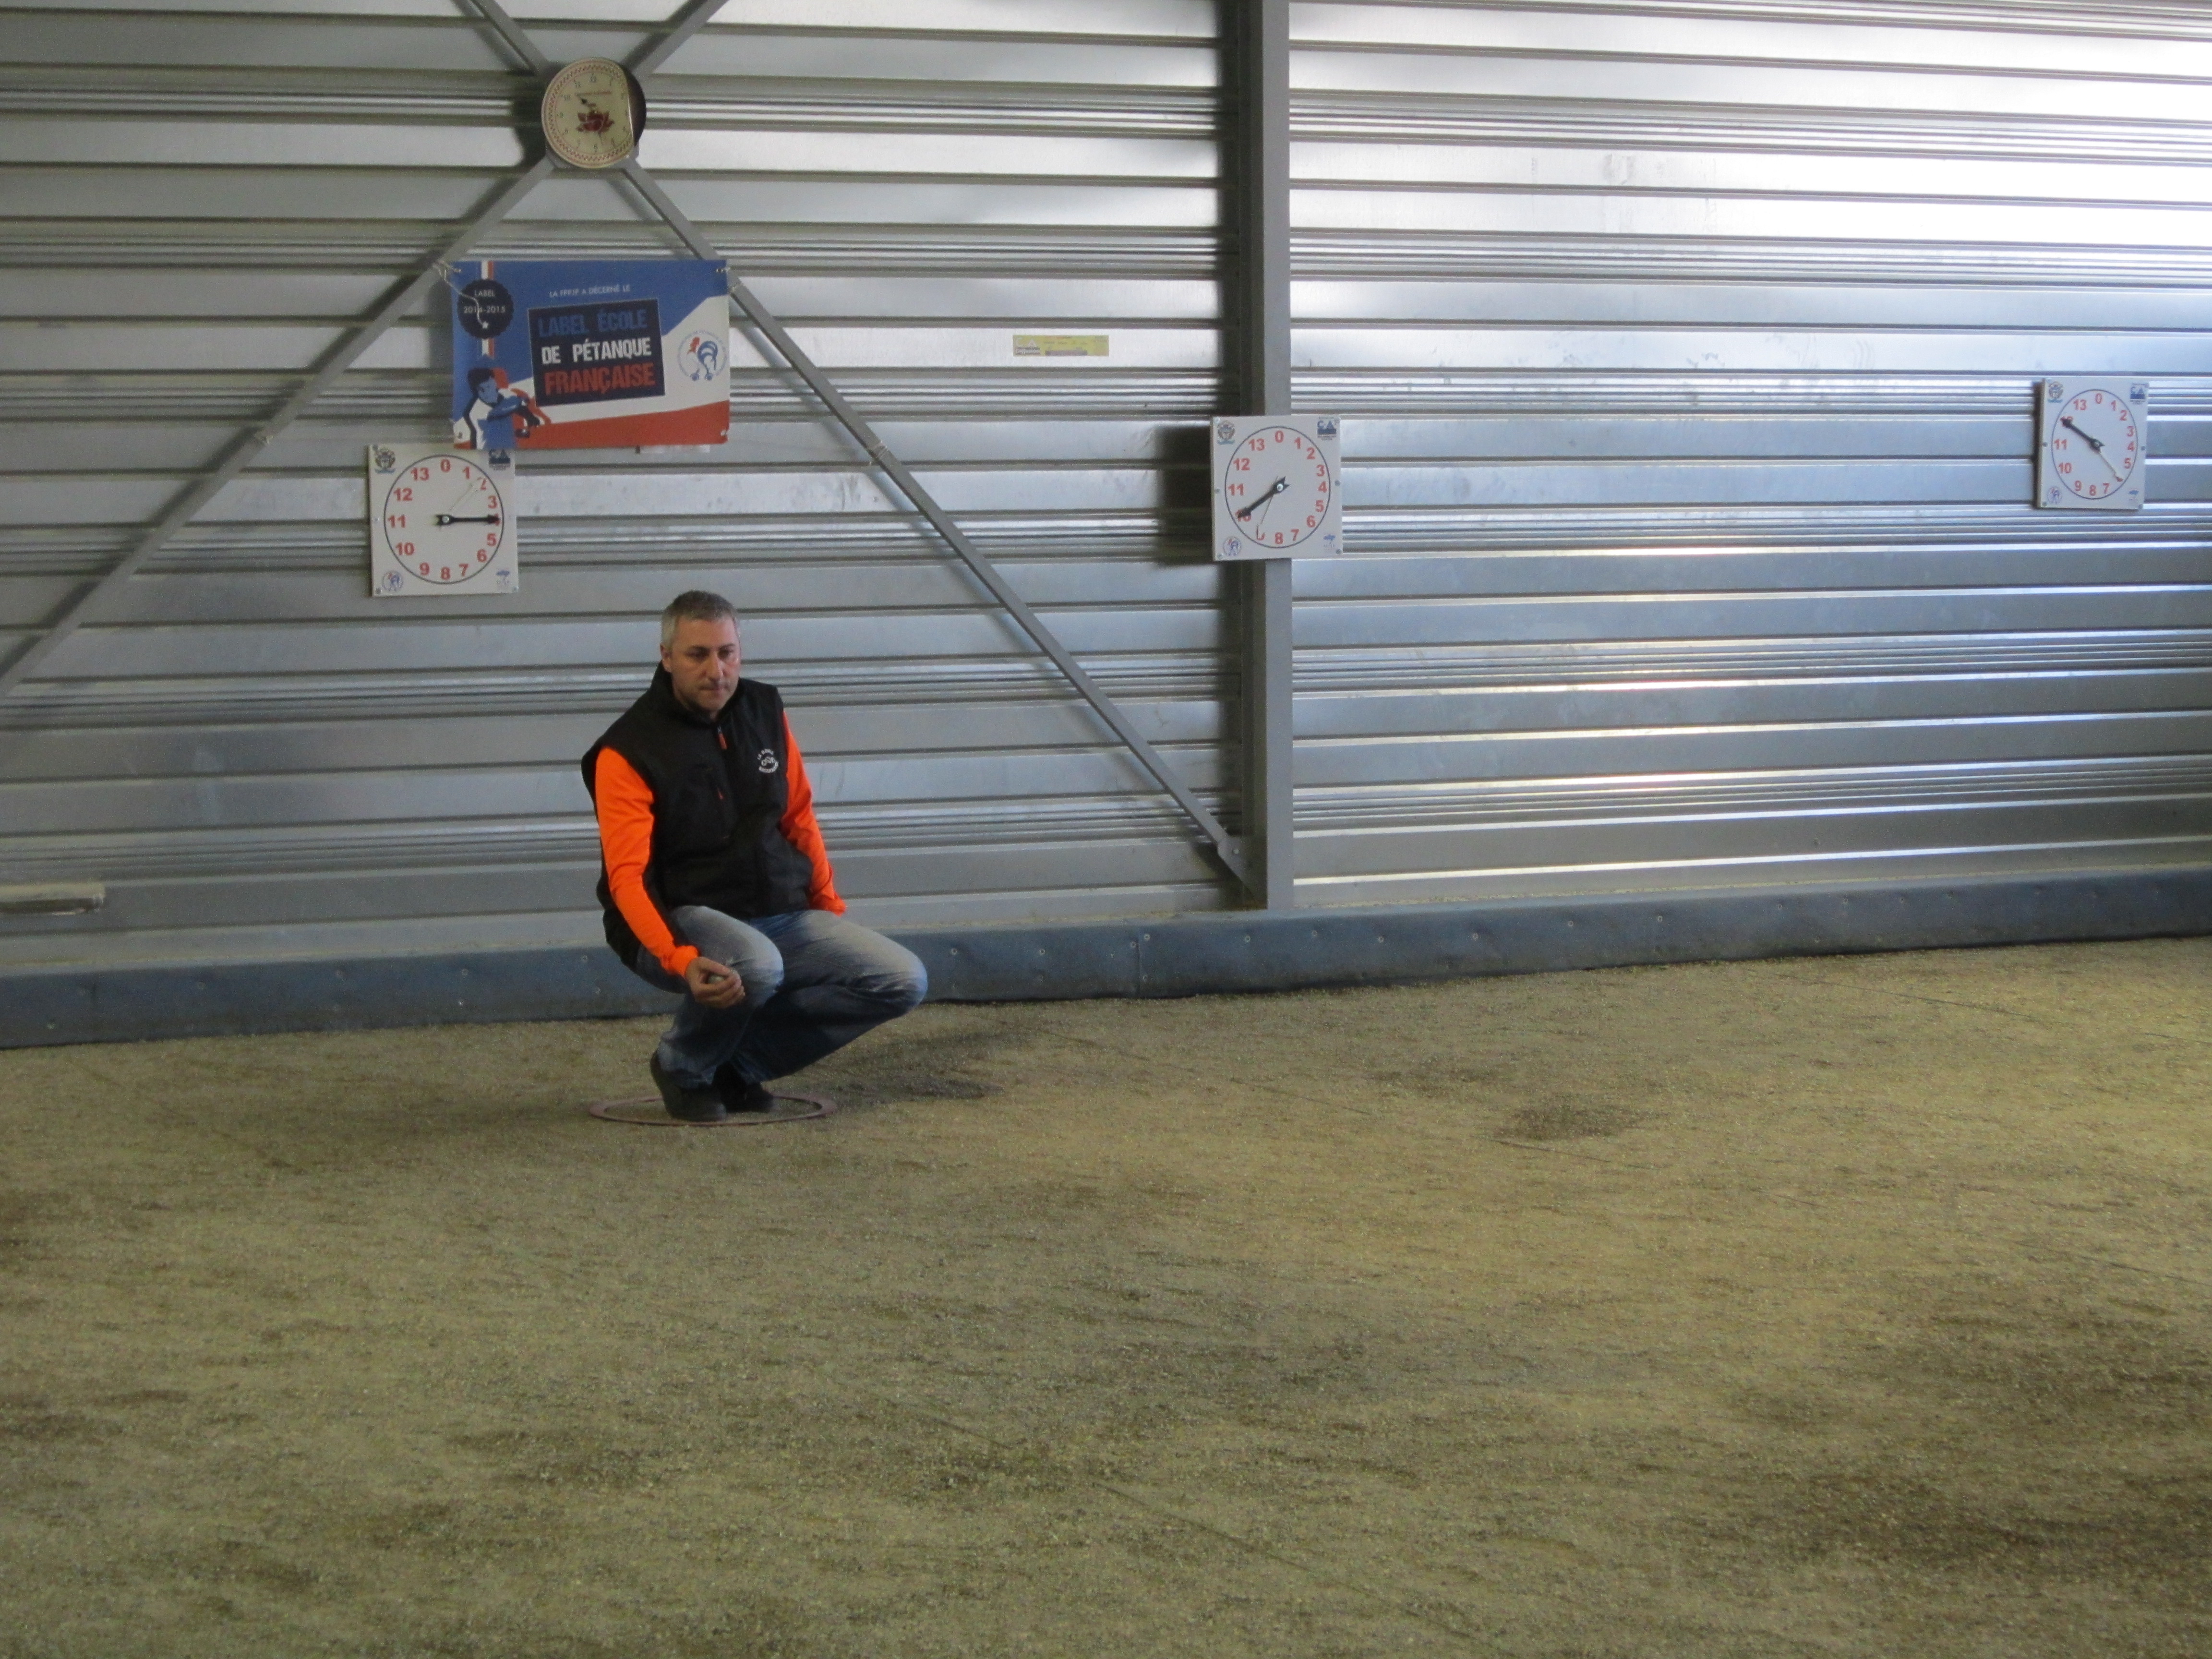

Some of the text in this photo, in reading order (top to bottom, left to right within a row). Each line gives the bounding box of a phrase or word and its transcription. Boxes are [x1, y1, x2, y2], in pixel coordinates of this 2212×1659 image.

[474, 289, 495, 297] LABEL
[589, 284, 620, 294] DÉCERNÉ
[538, 308, 648, 337] LABEL ÉCOLE
[541, 337, 652, 365] DE PÉTANQUE
[544, 362, 656, 396] FRANÇAISE
[2073, 399, 2087, 410] 13
[2094, 393, 2103, 404] 0
[2111, 400, 2117, 411] 1
[2119, 409, 2128, 421] 2
[1274, 430, 1285, 443] 0
[2126, 425, 2134, 437] 3
[1248, 438, 1265, 451] 13
[1294, 437, 1301, 450] 1
[2054, 439, 2068, 450] 11
[2127, 441, 2135, 452] 4
[1306, 447, 1316, 460] 2
[440, 458, 451, 473] 0
[1233, 457, 1250, 471] 12
[2058, 462, 2072, 474] 10
[2124, 457, 2132, 469] 5
[410, 467, 430, 481] 13
[462, 466, 471, 480] 1
[1316, 464, 1325, 477] 3
[1228, 483, 1245, 496] 11
[1318, 481, 1328, 493] 4
[2074, 480, 2082, 492] 9
[2089, 484, 2097, 496] 8
[2102, 482, 2110, 494] 7
[393, 488, 413, 502] 12
[488, 495, 498, 509] 3
[1315, 500, 1324, 513] 5
[387, 515, 406, 529] 11
[1306, 515, 1316, 528] 6
[487, 533, 497, 547] 5
[1274, 532, 1284, 545] 8
[1291, 529, 1299, 541] 7
[396, 542, 415, 556] 10
[477, 549, 488, 563] 6
[420, 562, 430, 576] 9
[440, 566, 451, 580] 8
[458, 563, 469, 576] 7
